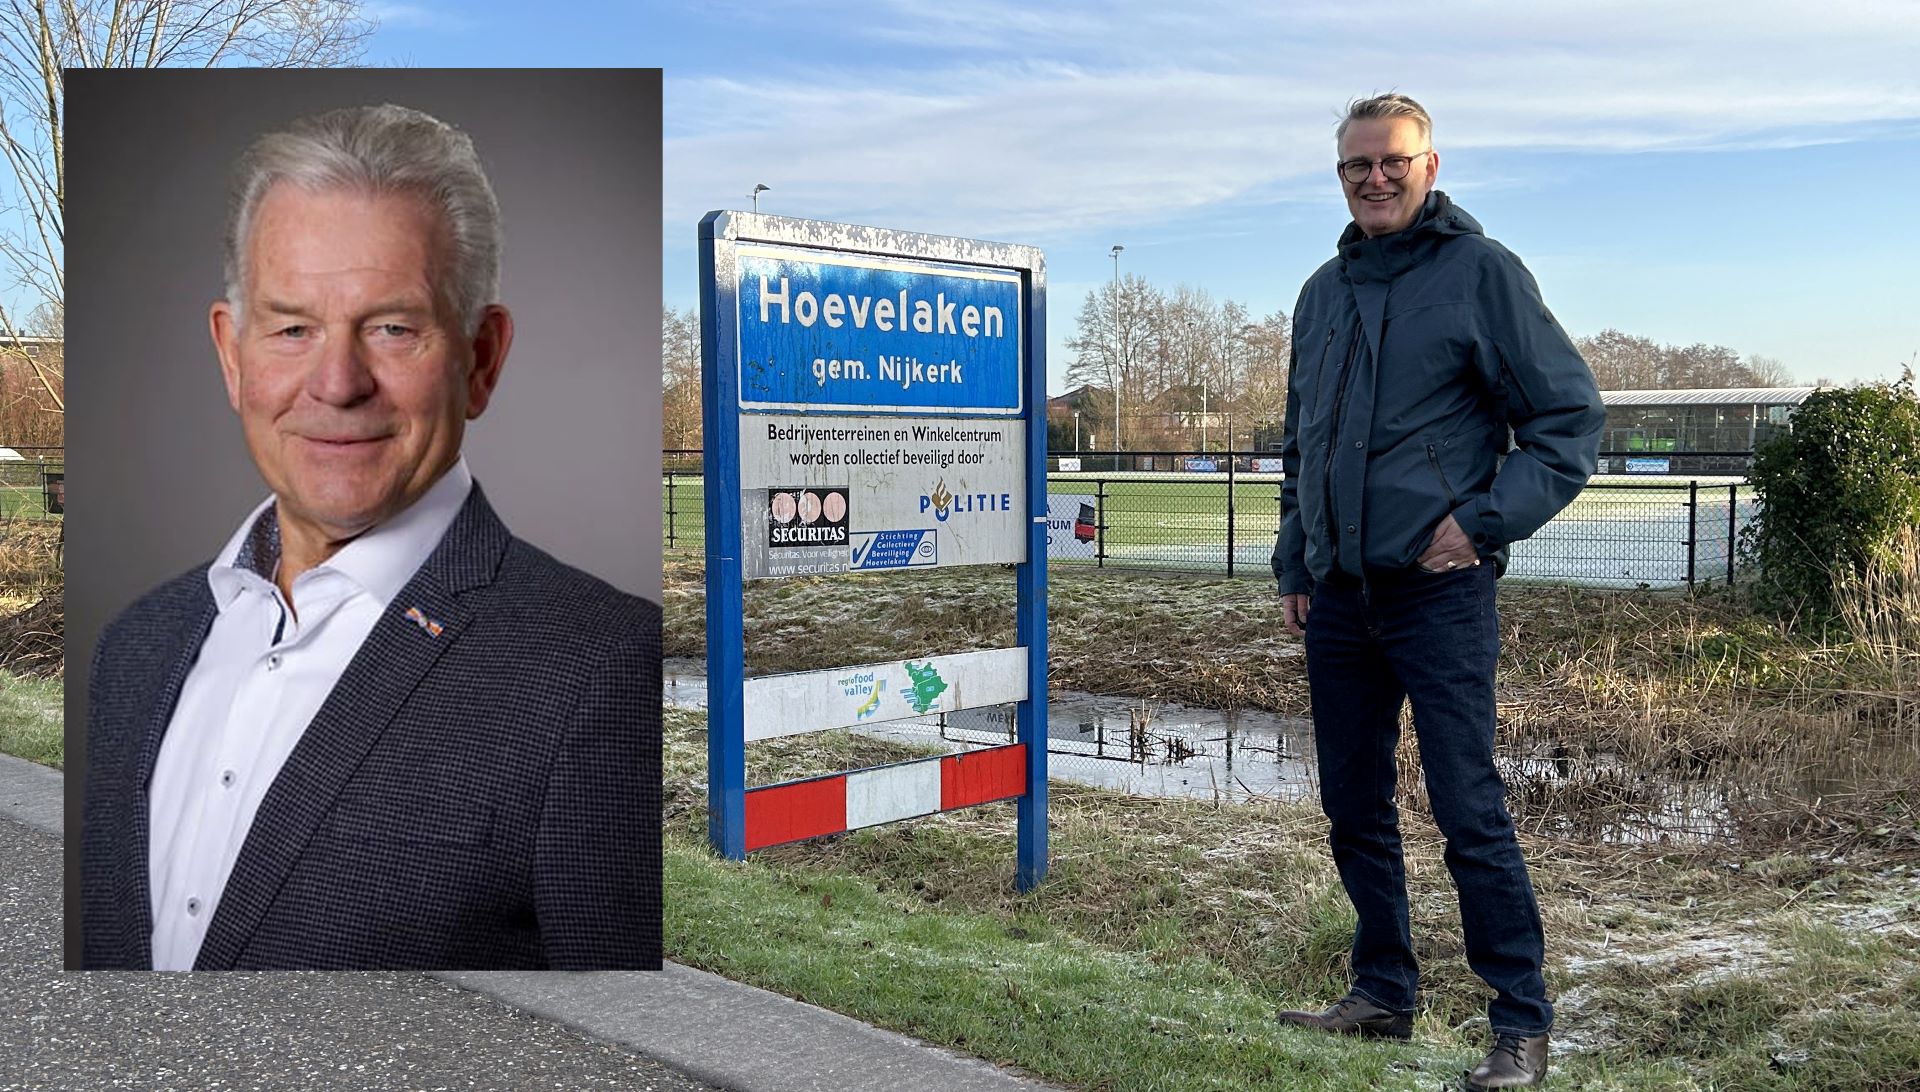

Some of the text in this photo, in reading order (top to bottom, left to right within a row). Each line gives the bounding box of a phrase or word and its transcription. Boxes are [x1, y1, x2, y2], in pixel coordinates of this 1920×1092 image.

[759, 275, 1004, 338] Hoevelaken
[812, 355, 963, 390] gem. Nijkerk
[767, 423, 1002, 445] Bedrijventerreinen en Winkelcentrum
[789, 448, 985, 469] worden collectief beveiligd door
[919, 493, 1010, 522] POLITIE
[772, 526, 846, 542] SECURITAS
[880, 532, 918, 541] Stichting
[865, 558, 906, 567] Hoevelaken
[871, 549, 910, 558] Beveiliging
[844, 684, 873, 696] valley
